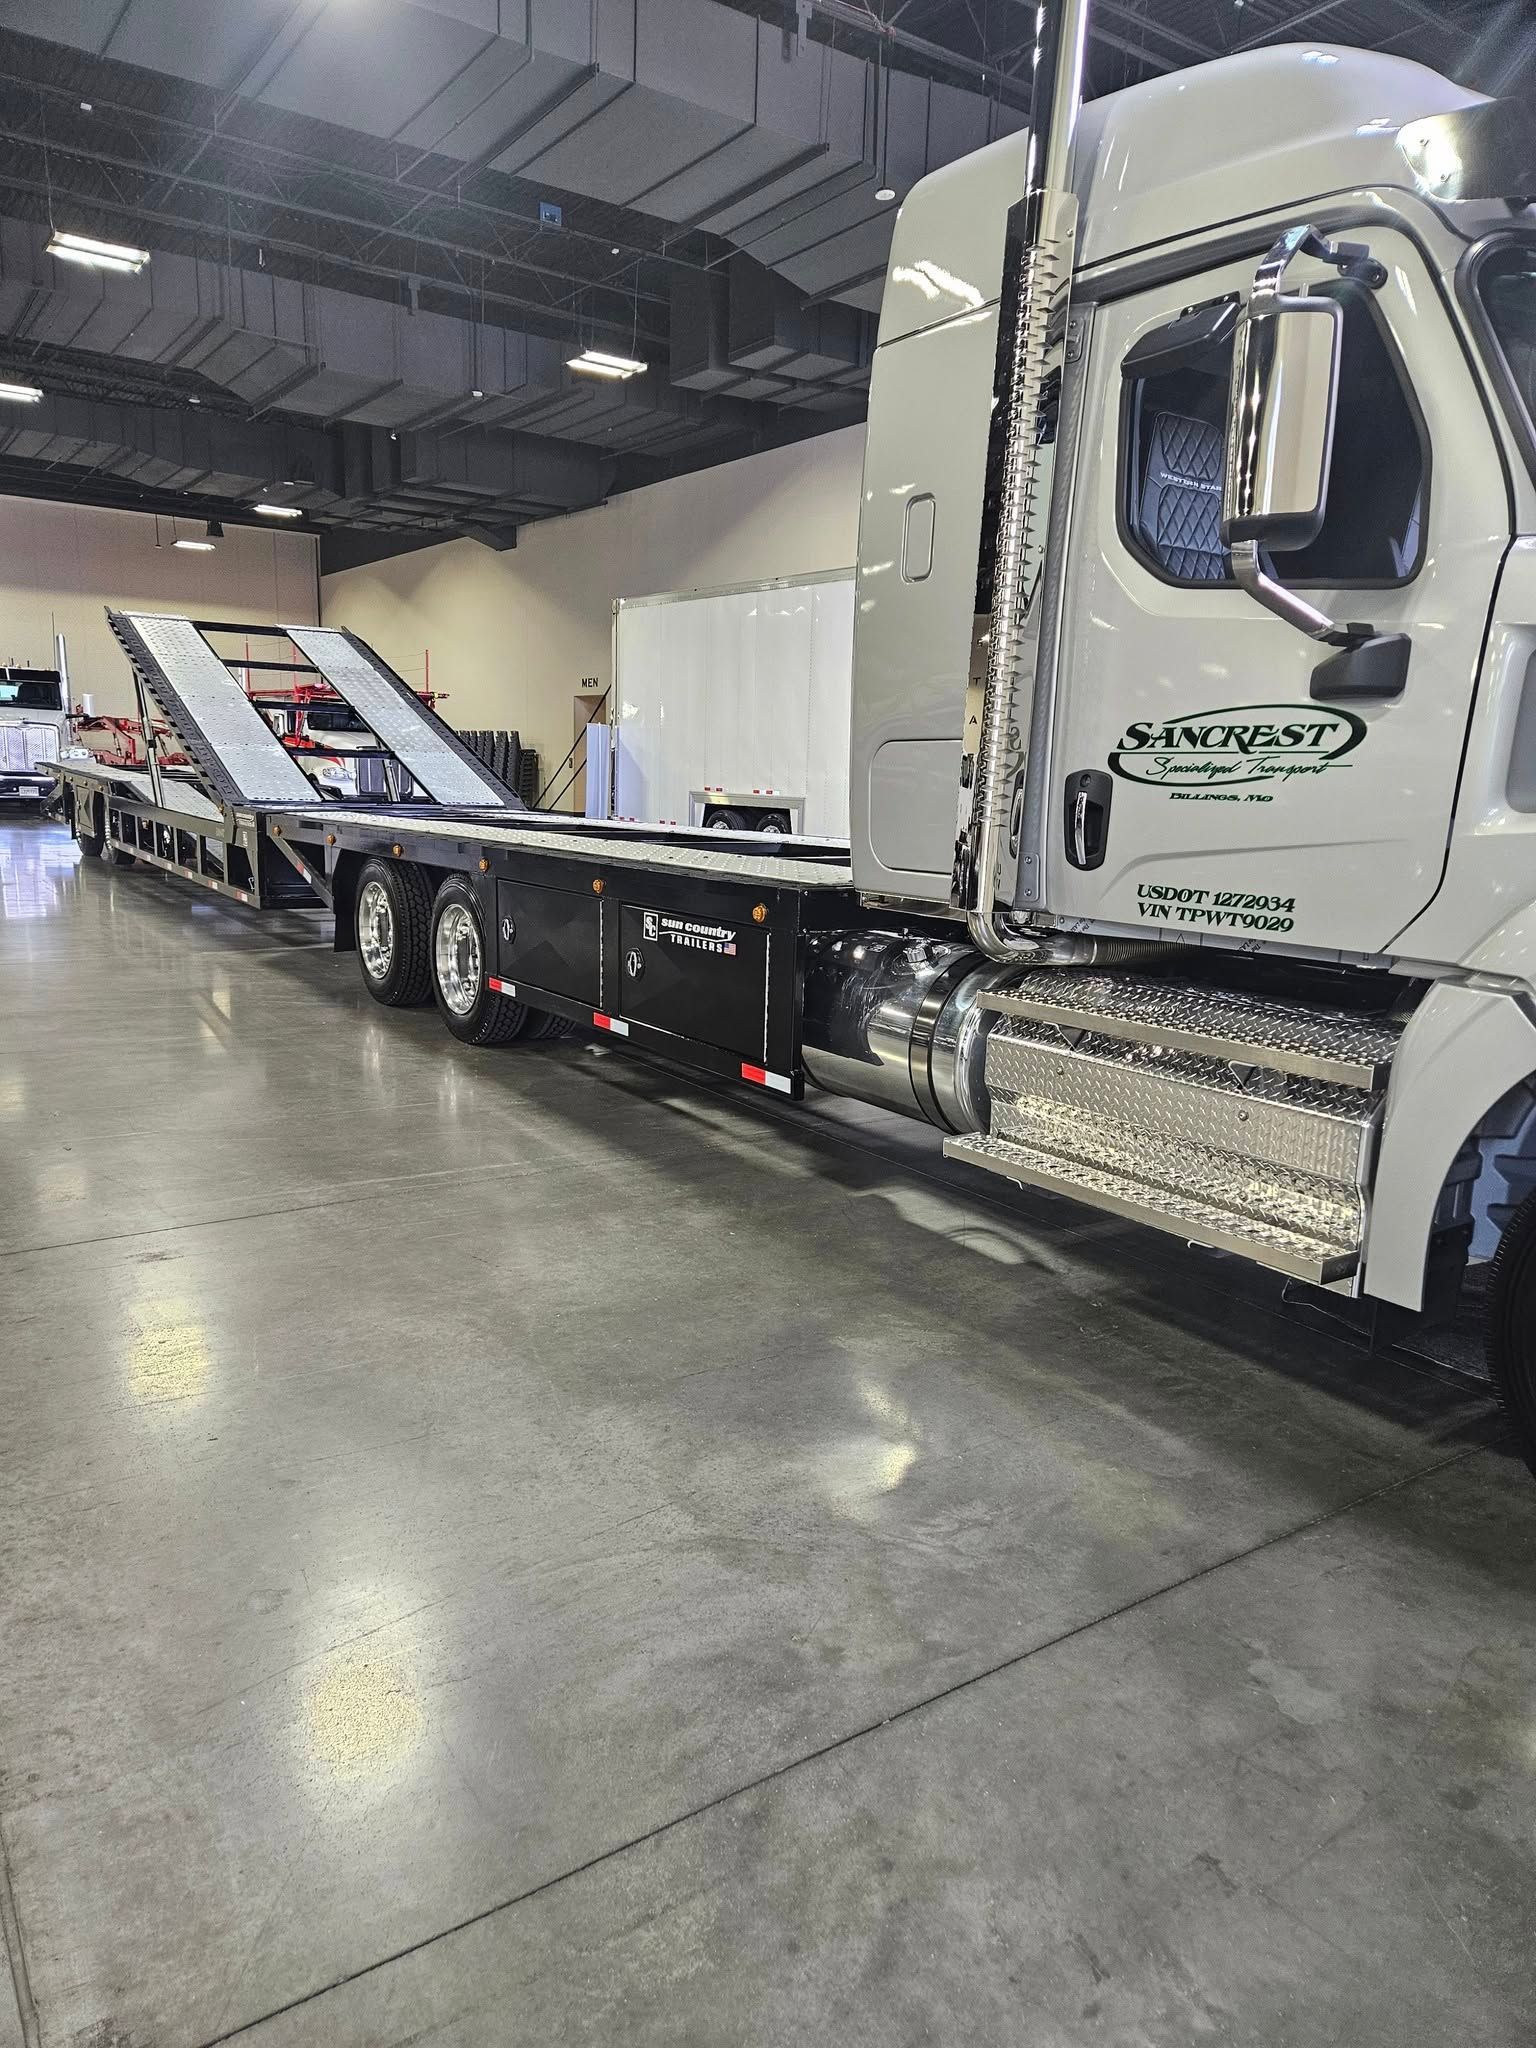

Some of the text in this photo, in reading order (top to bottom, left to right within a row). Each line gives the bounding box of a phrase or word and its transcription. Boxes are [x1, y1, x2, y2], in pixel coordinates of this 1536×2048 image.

[1160, 472, 1199, 488] WESTERN
[581, 677, 599, 688] MEN
[1117, 721, 1340, 754] SANCREST
[1146, 755, 1353, 782] Specialized Transport
[1169, 792, 1241, 802] BILLINGS,
[1137, 883, 1296, 913] USDOT 1272934
[1137, 902, 1295, 933] VIN TPWT9029
[661, 918, 737, 941] sun country
[670, 934, 723, 953] TRAILERS
